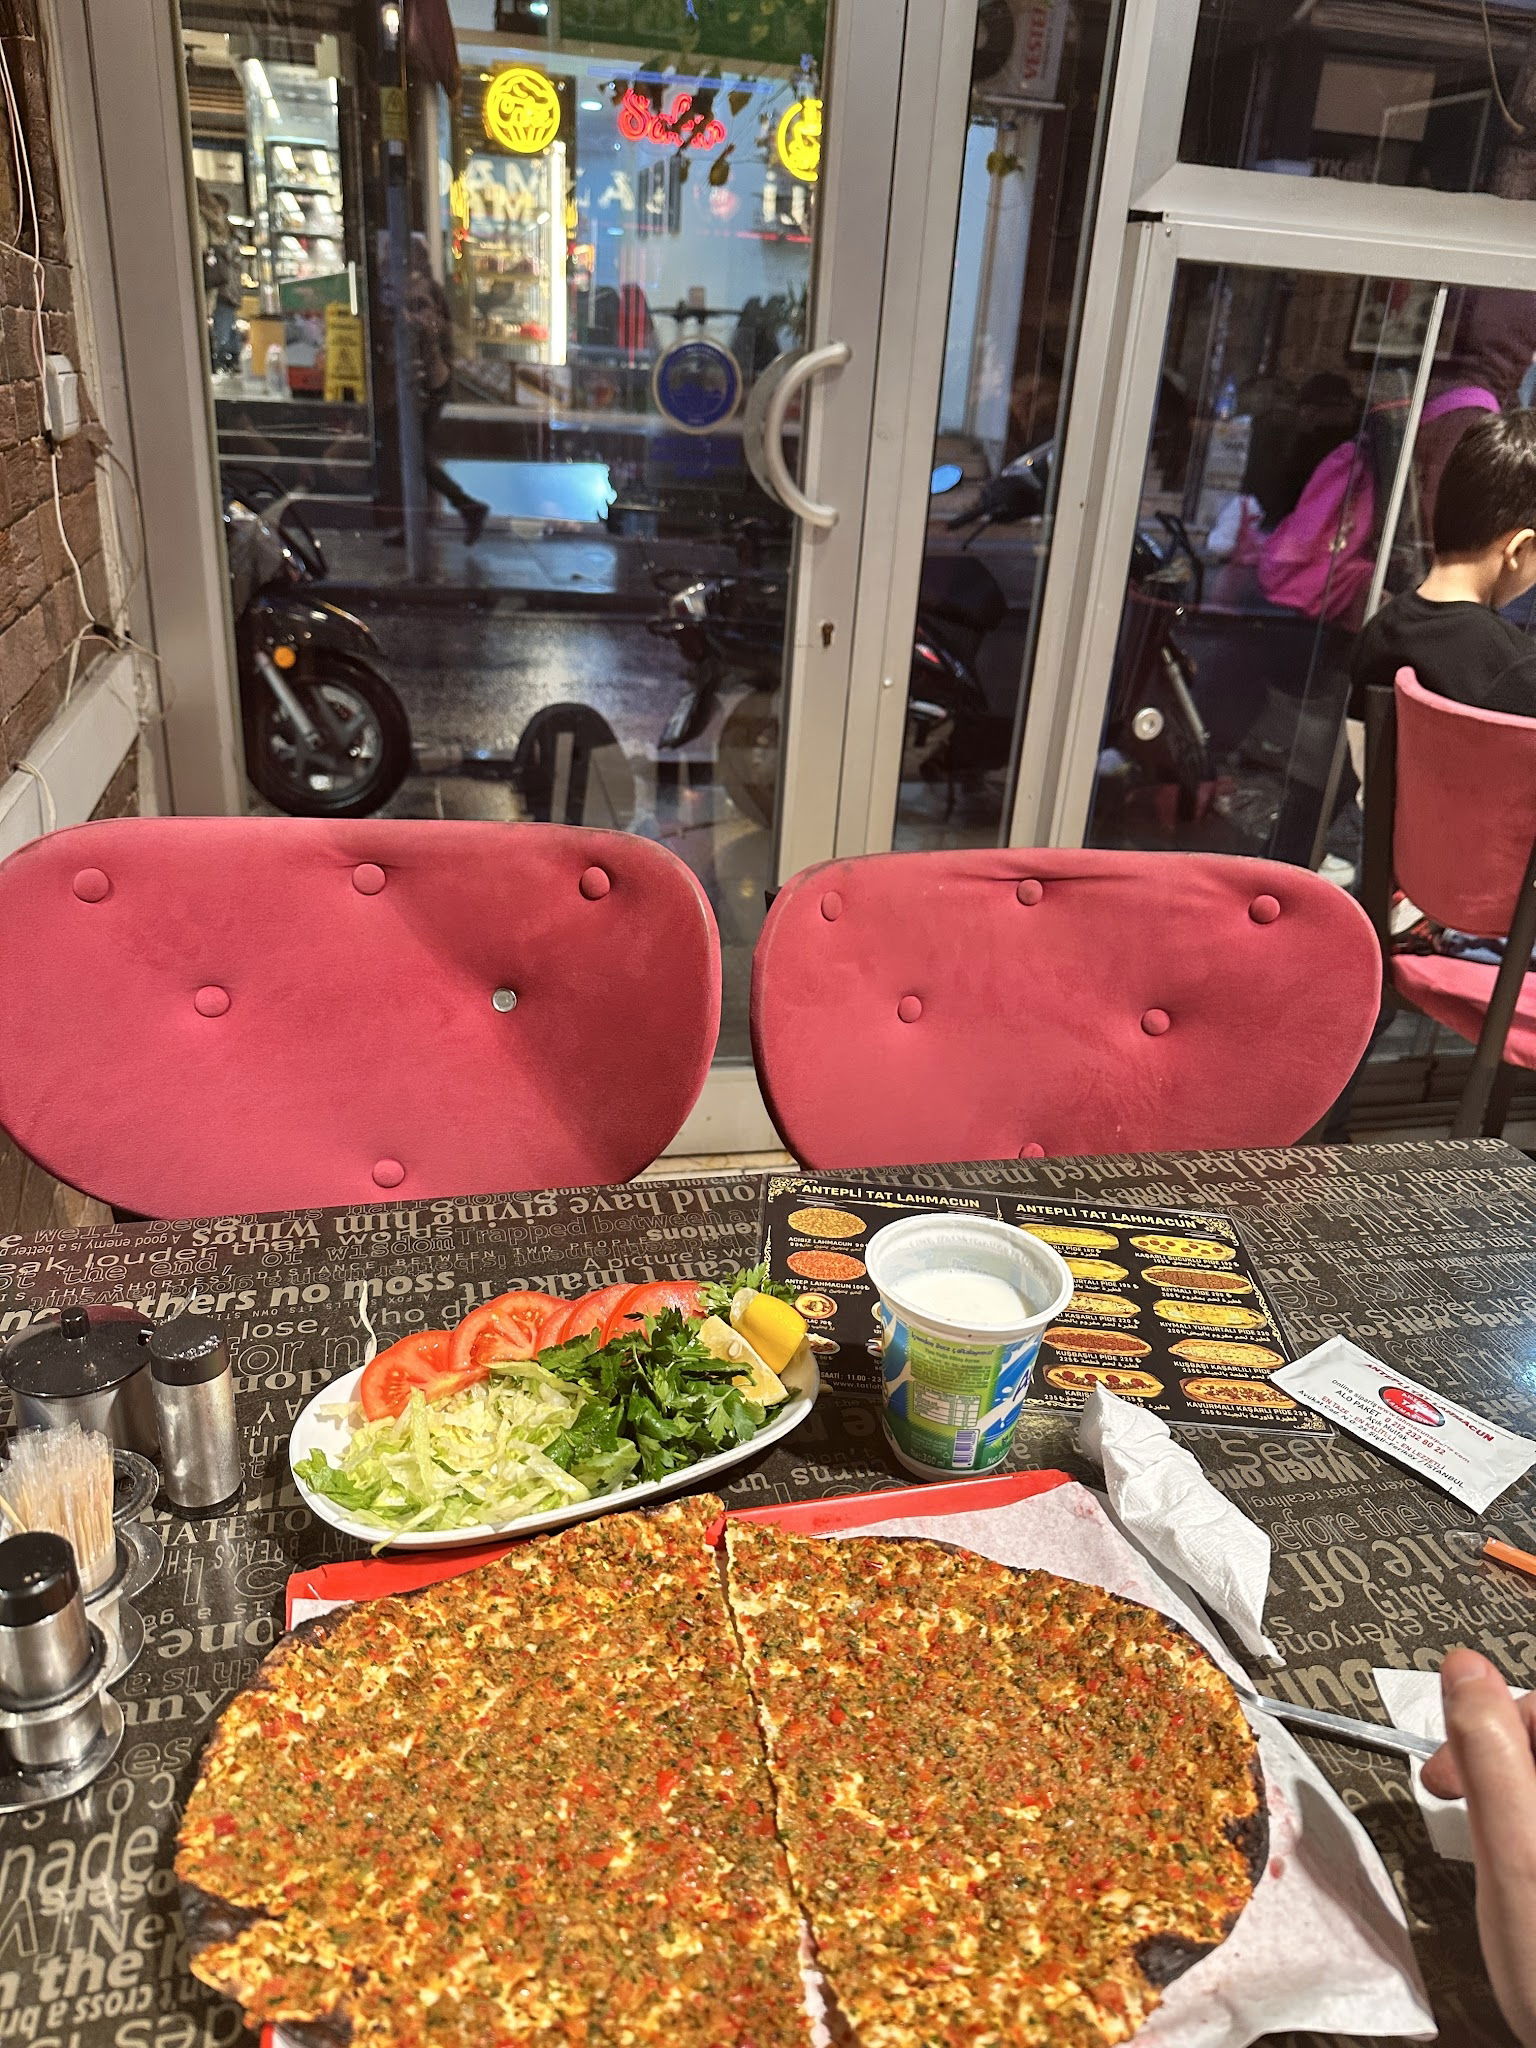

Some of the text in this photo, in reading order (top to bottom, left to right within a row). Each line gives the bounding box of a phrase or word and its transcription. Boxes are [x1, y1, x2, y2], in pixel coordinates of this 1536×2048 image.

[1346, 1140, 1434, 1155] wants
[1437, 1139, 1469, 1150] to
[1473, 1138, 1509, 1152] go
[957, 1165, 1038, 1187] man
[1044, 1160, 1173, 1189] wanted
[1171, 1157, 1249, 1182] had
[1240, 1154, 1318, 1179] God
[1187, 1180, 1262, 1199] loses
[1264, 1174, 1362, 1192] nothing
[1362, 1170, 1401, 1187] by
[1400, 1165, 1494, 1186] lighting
[801, 1184, 981, 1208] ANTEPLİ TAT LAHMACUN
[191, 1184, 757, 1248] ould have giving him wings
[1016, 1204, 1197, 1229] ANTEPLİ TAT LAHMACUN
[1345, 1207, 1470, 1237] DESERVE
[13, 1242, 54, 1257] better
[71, 1241, 82, 1252] is
[84, 1238, 132, 1252] enemy
[85, 1225, 455, 1269] louder than words
[134, 1235, 170, 1249] good
[172, 1233, 182, 1246] A
[813, 1239, 853, 1248] LAHMACUN
[1308, 1239, 1359, 1251] Beware
[1382, 1232, 1430, 1246] Greeks
[1408, 1242, 1459, 1257] inch
[1485, 1236, 1534, 1249] him
[63, 1262, 128, 1287] the
[326, 1234, 456, 1262] wisdom
[584, 1247, 717, 1272] A picture is
[1265, 1251, 1317, 1265] take
[1366, 1245, 1408, 1260] and
[50, 1286, 94, 1298] THE
[114, 1273, 237, 1293] SHORTEST
[256, 1260, 377, 1281] DISTANCE
[396, 1250, 495, 1267] BETWEEN
[810, 1279, 852, 1289] LAHMACUN
[270, 1271, 455, 1308] no moss
[459, 1279, 498, 1304] it
[252, 1308, 279, 1319] OWN
[289, 1305, 314, 1315] ITS
[241, 1318, 330, 1342] lose,
[1332, 1380, 1354, 1394] Online
[1186, 1402, 1235, 1413] KAVURMALI
[1412, 1390, 1432, 1401] TAT
[1432, 1402, 1495, 1443] LAHMACUN
[1321, 1395, 1333, 1405] EN
[1332, 1400, 1351, 1416] TAZE
[1353, 1415, 1365, 1426] EN
[1400, 1442, 1413, 1452] EN
[1335, 1389, 1353, 1402] ALO
[1352, 1400, 1382, 1418] PAKET
[1391, 1420, 1406, 1432] 212
[1405, 1429, 1422, 1442] 232
[1421, 1439, 1434, 1449] 80
[1433, 1446, 1447, 1456] 22
[1382, 1423, 1408, 1442] Mutfak
[1222, 1436, 1354, 1472] Seek
[1266, 1455, 1371, 1484] When
[1249, 1484, 1379, 1510] is past recalling
[266, 1508, 313, 1535] TO
[1357, 1497, 1430, 1538] the
[1279, 1545, 1372, 1612] off
[1362, 1578, 1453, 1621] Give
[1426, 1597, 1536, 1637] thinks
[38, 1947, 145, 2001] the
[46, 2000, 68, 2028] a
[73, 1984, 154, 2023] cross
